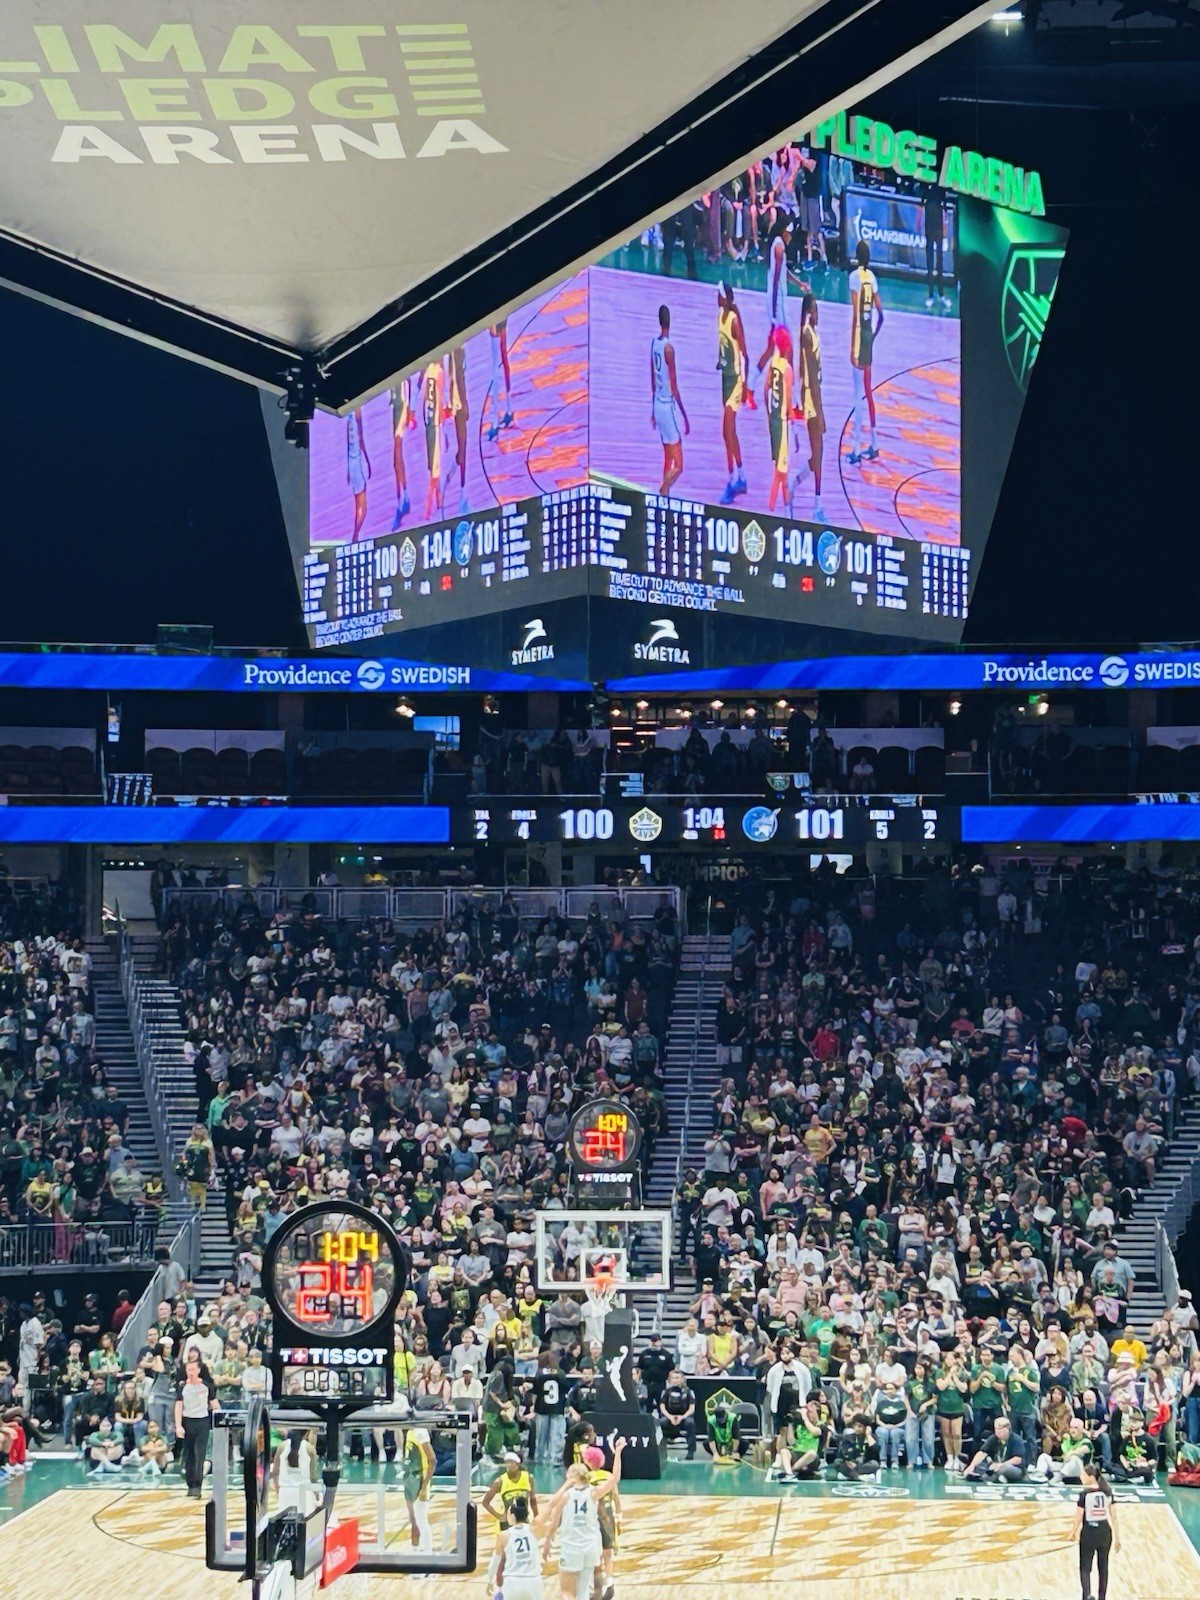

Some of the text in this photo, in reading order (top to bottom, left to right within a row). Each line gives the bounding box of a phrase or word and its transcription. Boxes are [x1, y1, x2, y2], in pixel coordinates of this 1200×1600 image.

[51, 120, 510, 164] ARENA
[940, 146, 1046, 217] ARENA
[374, 545, 398, 579] 100
[421, 529, 452, 569] 1:04
[476, 520, 499, 556] 101
[705, 518, 739, 554] 100
[774, 527, 813, 566] 1:04
[845, 541, 872, 575] 101
[512, 645, 554, 665] SYMETRA
[634, 643, 690, 664] SYMETRA
[244, 664, 470, 685] Providence SWEDISH
[983, 660, 1094, 682] Providence
[476, 807, 935, 839] 2 4 100 1:04 101 5 2
[583, 1131, 624, 1161] 24
[593, 1173, 633, 1183] TISSOT
[322, 1231, 379, 1262] 1:04
[296, 1263, 373, 1322] 24
[308, 1348, 388, 1364] TISSOT
[544, 1380, 559, 1404] 3
[574, 1499, 587, 1514] 14
[515, 1537, 530, 1553] 21
